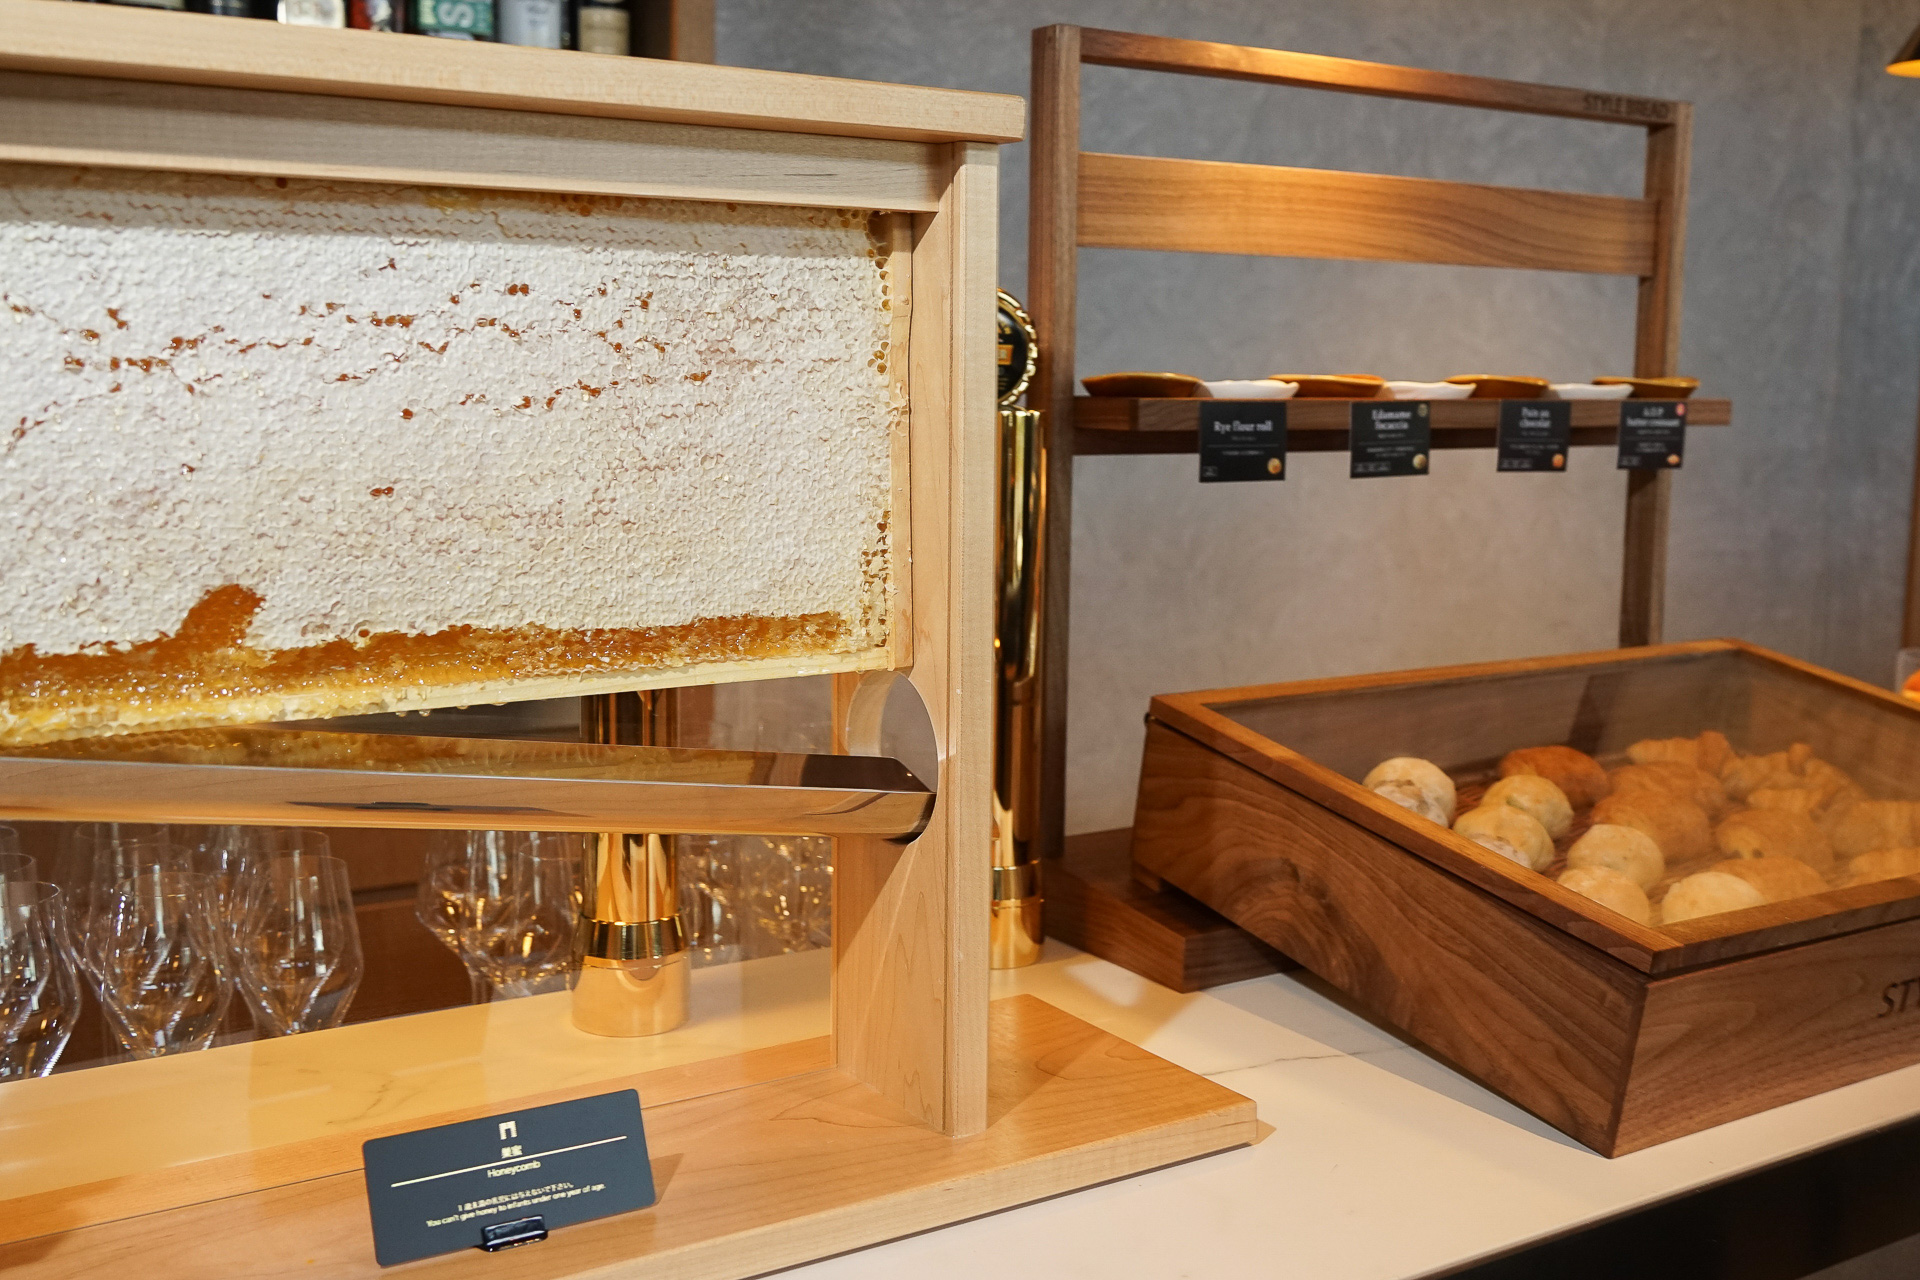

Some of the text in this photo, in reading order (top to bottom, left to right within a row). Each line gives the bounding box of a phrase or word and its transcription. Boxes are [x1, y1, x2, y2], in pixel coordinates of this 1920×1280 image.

[1213, 419, 1273, 434] Rye flour roll
[487, 1160, 541, 1178] Honeycomb
[426, 1183, 606, 1228] You can't give honey to infants under one year of age.
